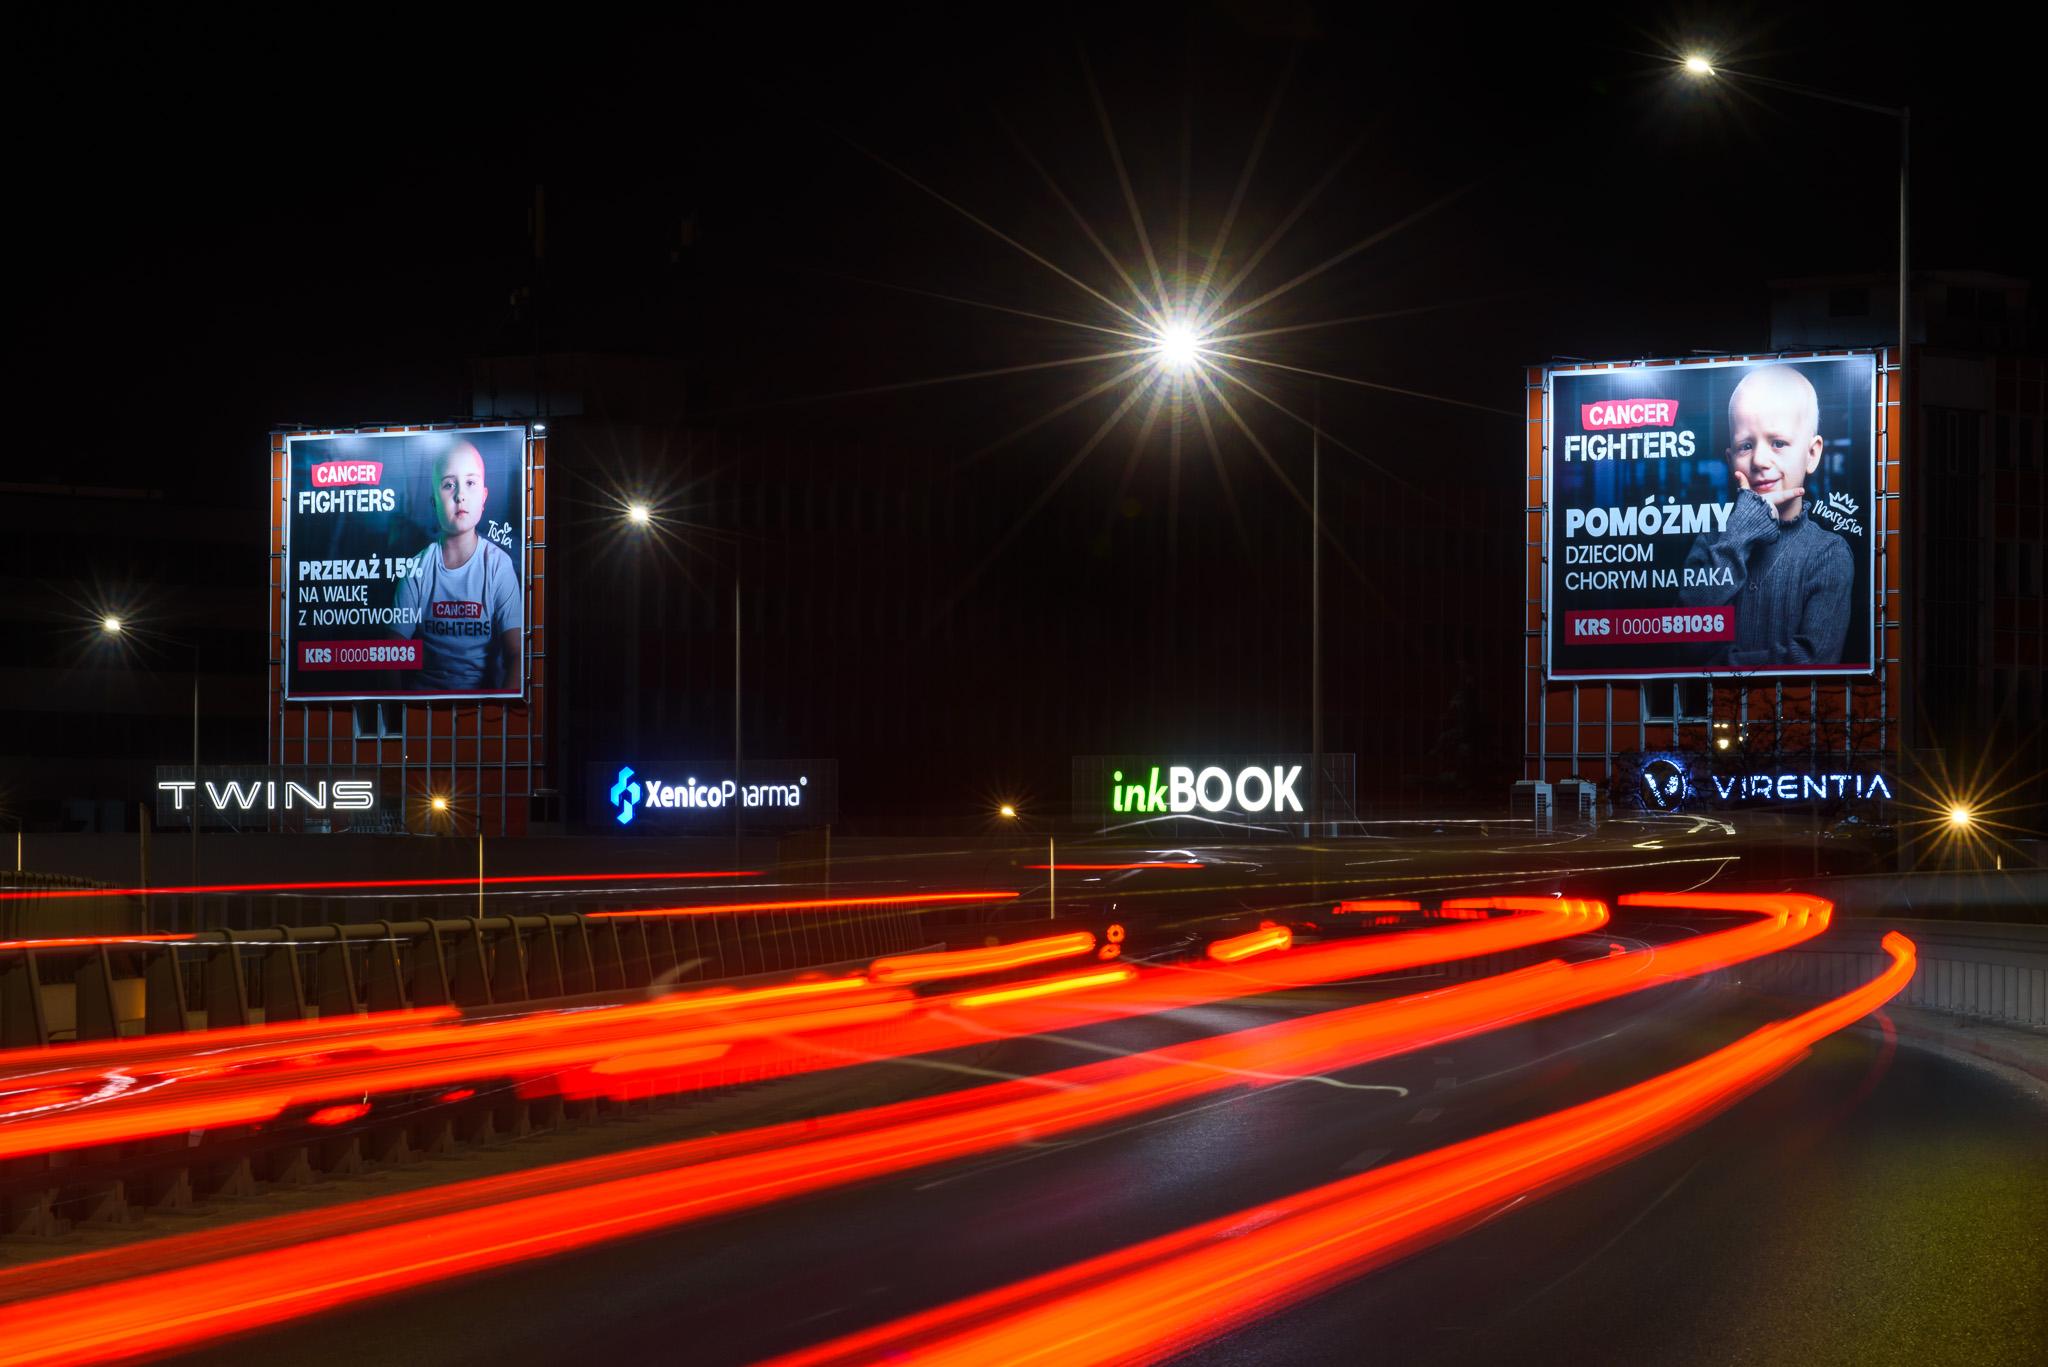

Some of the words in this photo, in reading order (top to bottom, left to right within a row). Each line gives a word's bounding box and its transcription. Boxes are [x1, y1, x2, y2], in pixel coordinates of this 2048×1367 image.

[1589, 403, 1670, 426] CANCER
[1564, 430, 1696, 462] FIGHTERS
[317, 464, 376, 483] CANCER
[298, 489, 395, 514] FIGHTERS
[1565, 494, 1734, 538] POMÓŻMY
[1812, 499, 1863, 536] Marysia
[488, 519, 513, 549] Tosia
[1565, 543, 1654, 565] DZIECIOM
[299, 553, 380, 581] PRZEKAŻ
[384, 557, 423, 583] 1,5%
[1565, 570, 1648, 591] CHORYM
[1652, 568, 1679, 588] NA
[1683, 566, 1735, 588] RAKA
[299, 586, 319, 603] NA
[323, 585, 368, 606] WALKĘ
[298, 610, 307, 626] Z
[313, 607, 422, 625] NOWOTWOREM
[436, 603, 478, 617] CANCER
[424, 620, 491, 636] FIGHTERS
[1574, 618, 1610, 636] KRS
[1622, 614, 1725, 635] 0000581036
[305, 648, 332, 664] KRS
[340, 646, 416, 663] 0000581036
[158, 781, 374, 810] TWINS
[1113, 765, 1304, 813] inkBOOK
[1712, 774, 1892, 799] VIRENTIA
